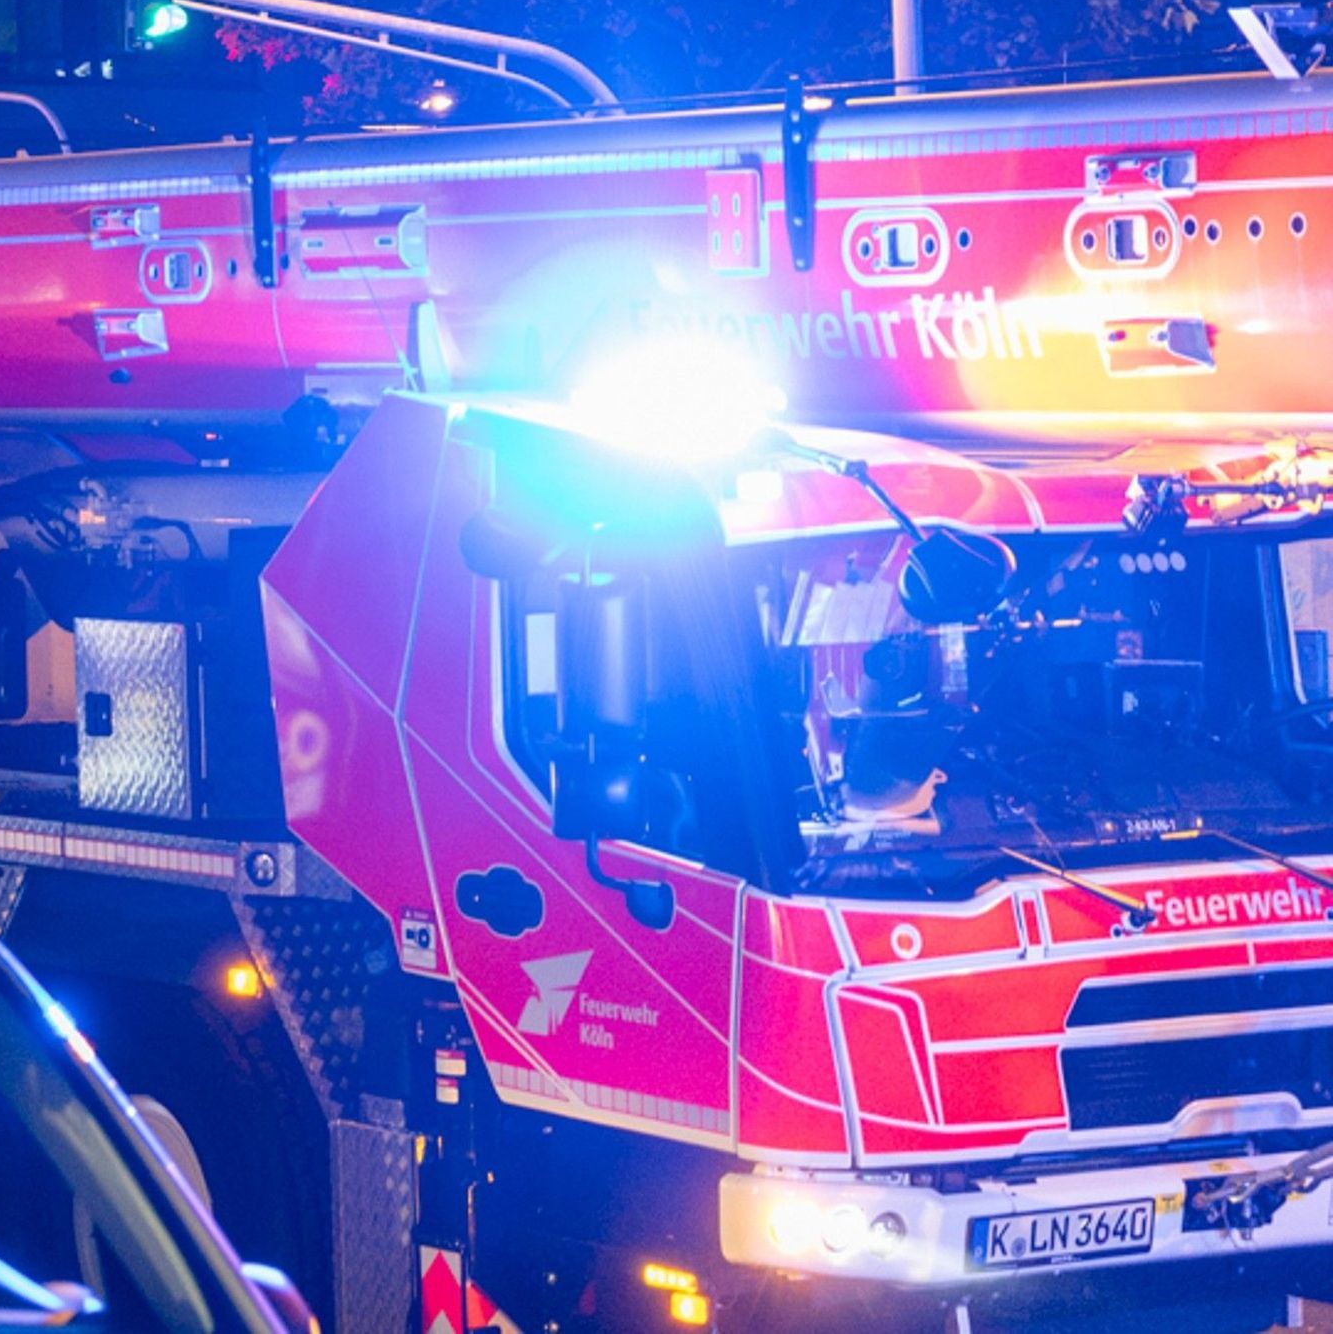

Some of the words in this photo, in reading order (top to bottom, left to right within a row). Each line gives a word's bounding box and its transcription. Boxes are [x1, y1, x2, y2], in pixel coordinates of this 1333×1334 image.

[911, 286, 1045, 360] Köln
[1145, 876, 1323, 929] Feuerwehr
[579, 992, 660, 1027] Feuerwehr
[579, 1022, 615, 1050] Köln
[990, 1222, 1011, 1258] K
[1030, 1215, 1071, 1254] LN
[1075, 1206, 1148, 1248] 3640
